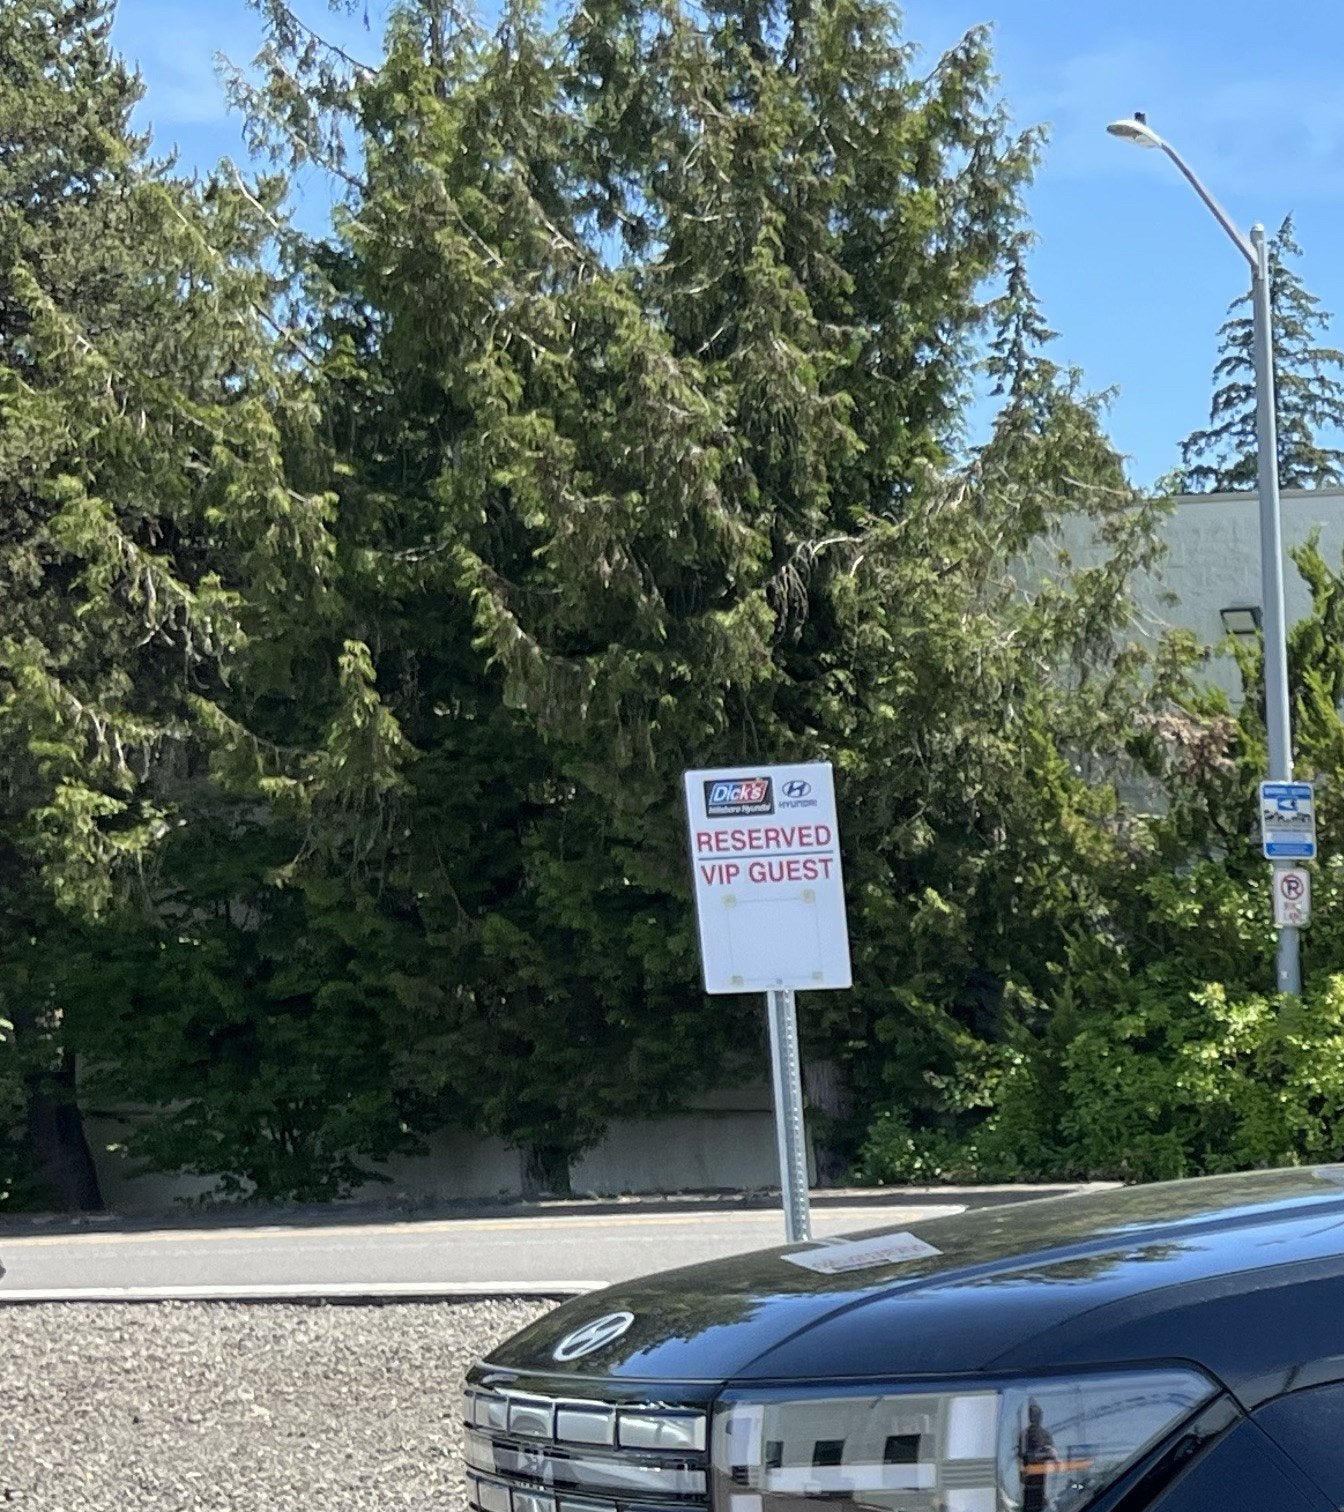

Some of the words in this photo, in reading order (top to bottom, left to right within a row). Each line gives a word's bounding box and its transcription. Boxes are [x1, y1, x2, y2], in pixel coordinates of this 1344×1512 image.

[697, 825, 831, 852] RESERVED
[701, 863, 740, 885] VIP
[750, 858, 834, 883] GUEST
